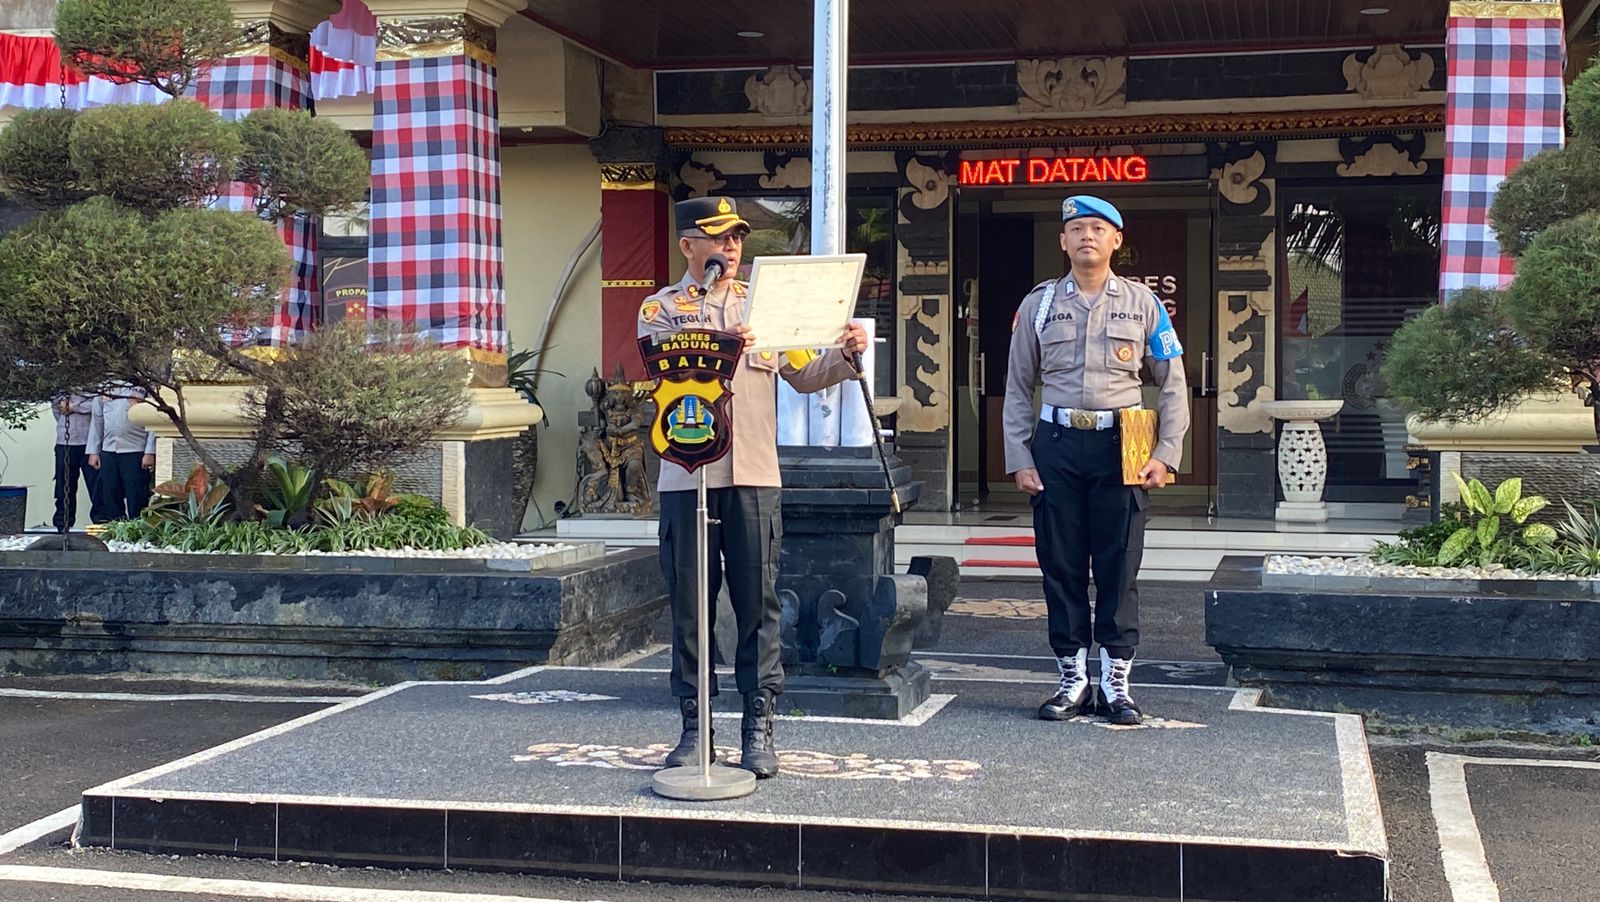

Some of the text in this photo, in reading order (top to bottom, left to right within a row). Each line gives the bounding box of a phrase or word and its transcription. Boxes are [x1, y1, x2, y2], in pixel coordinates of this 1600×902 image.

[1029, 156, 1146, 183] DATANG
[335, 289, 368, 297] PROPA
[1110, 312, 1143, 321] POLRI
[670, 333, 711, 342] POLRES
[661, 341, 720, 352] BADUNG
[658, 356, 722, 371] BALI
